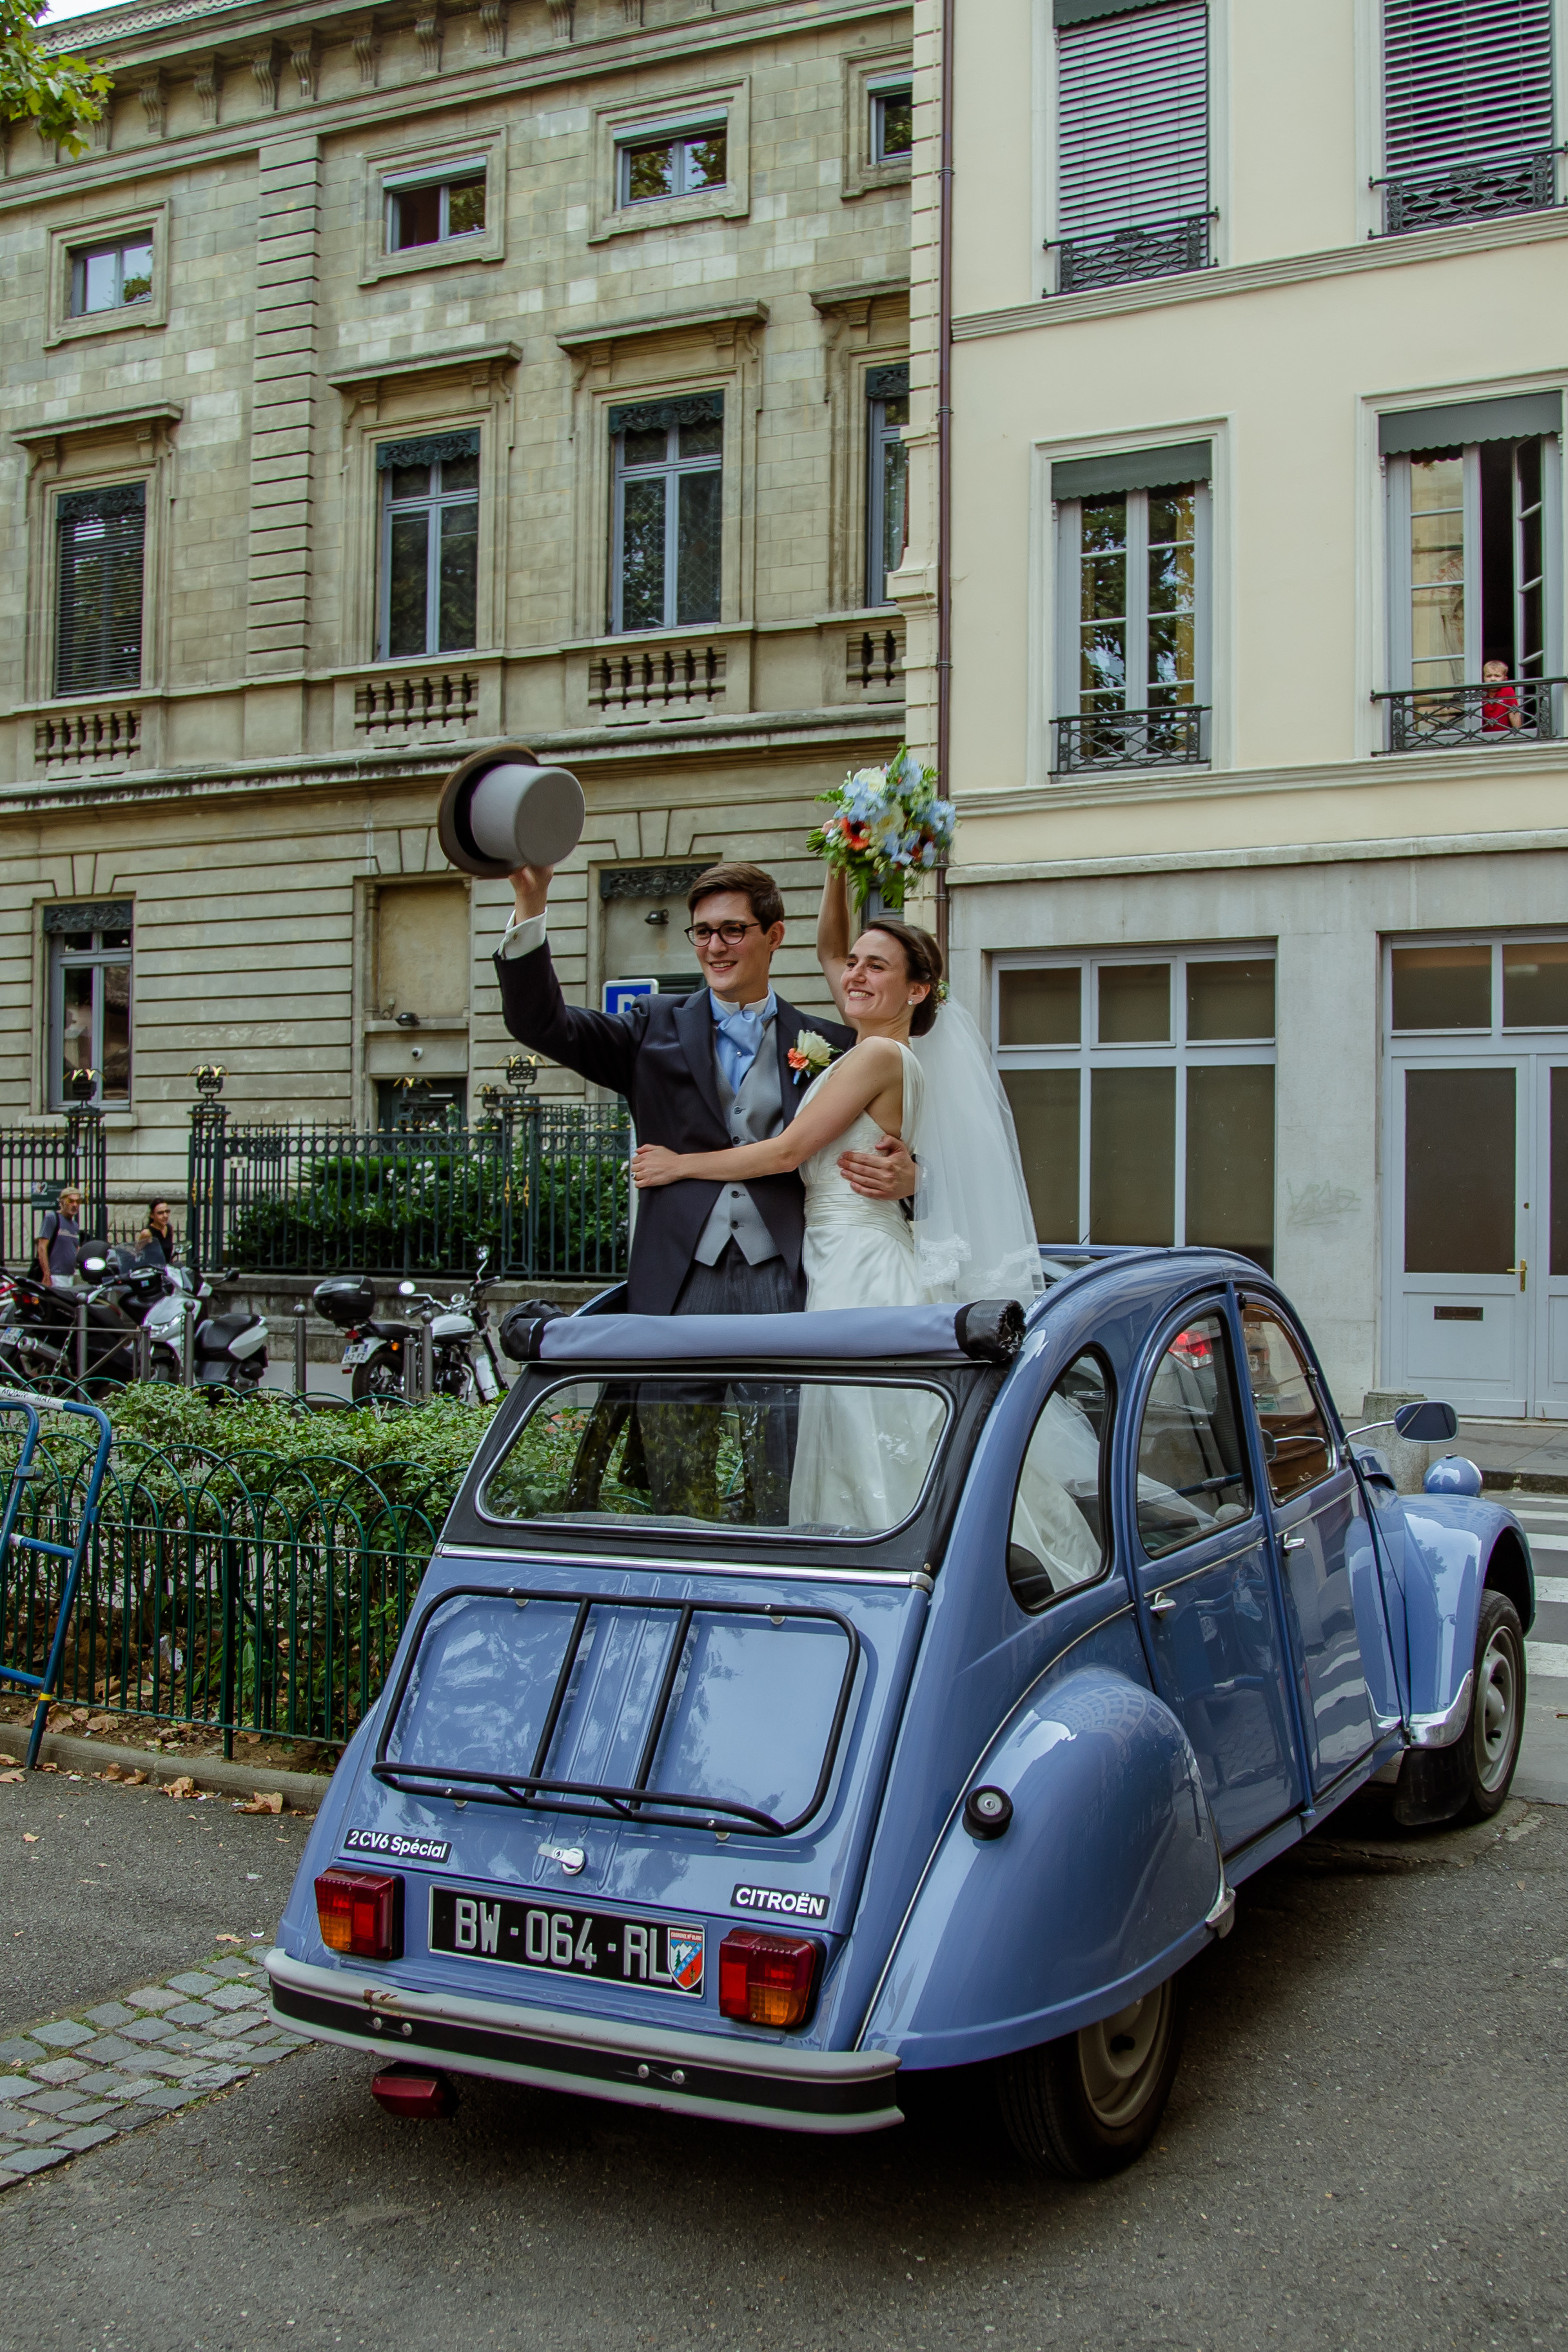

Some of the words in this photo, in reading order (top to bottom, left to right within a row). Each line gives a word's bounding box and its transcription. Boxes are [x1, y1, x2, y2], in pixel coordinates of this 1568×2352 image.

[348, 1830, 389, 1849] 2CV6
[390, 1836, 447, 1858] Spécial
[736, 1886, 825, 1916] CITROËN
